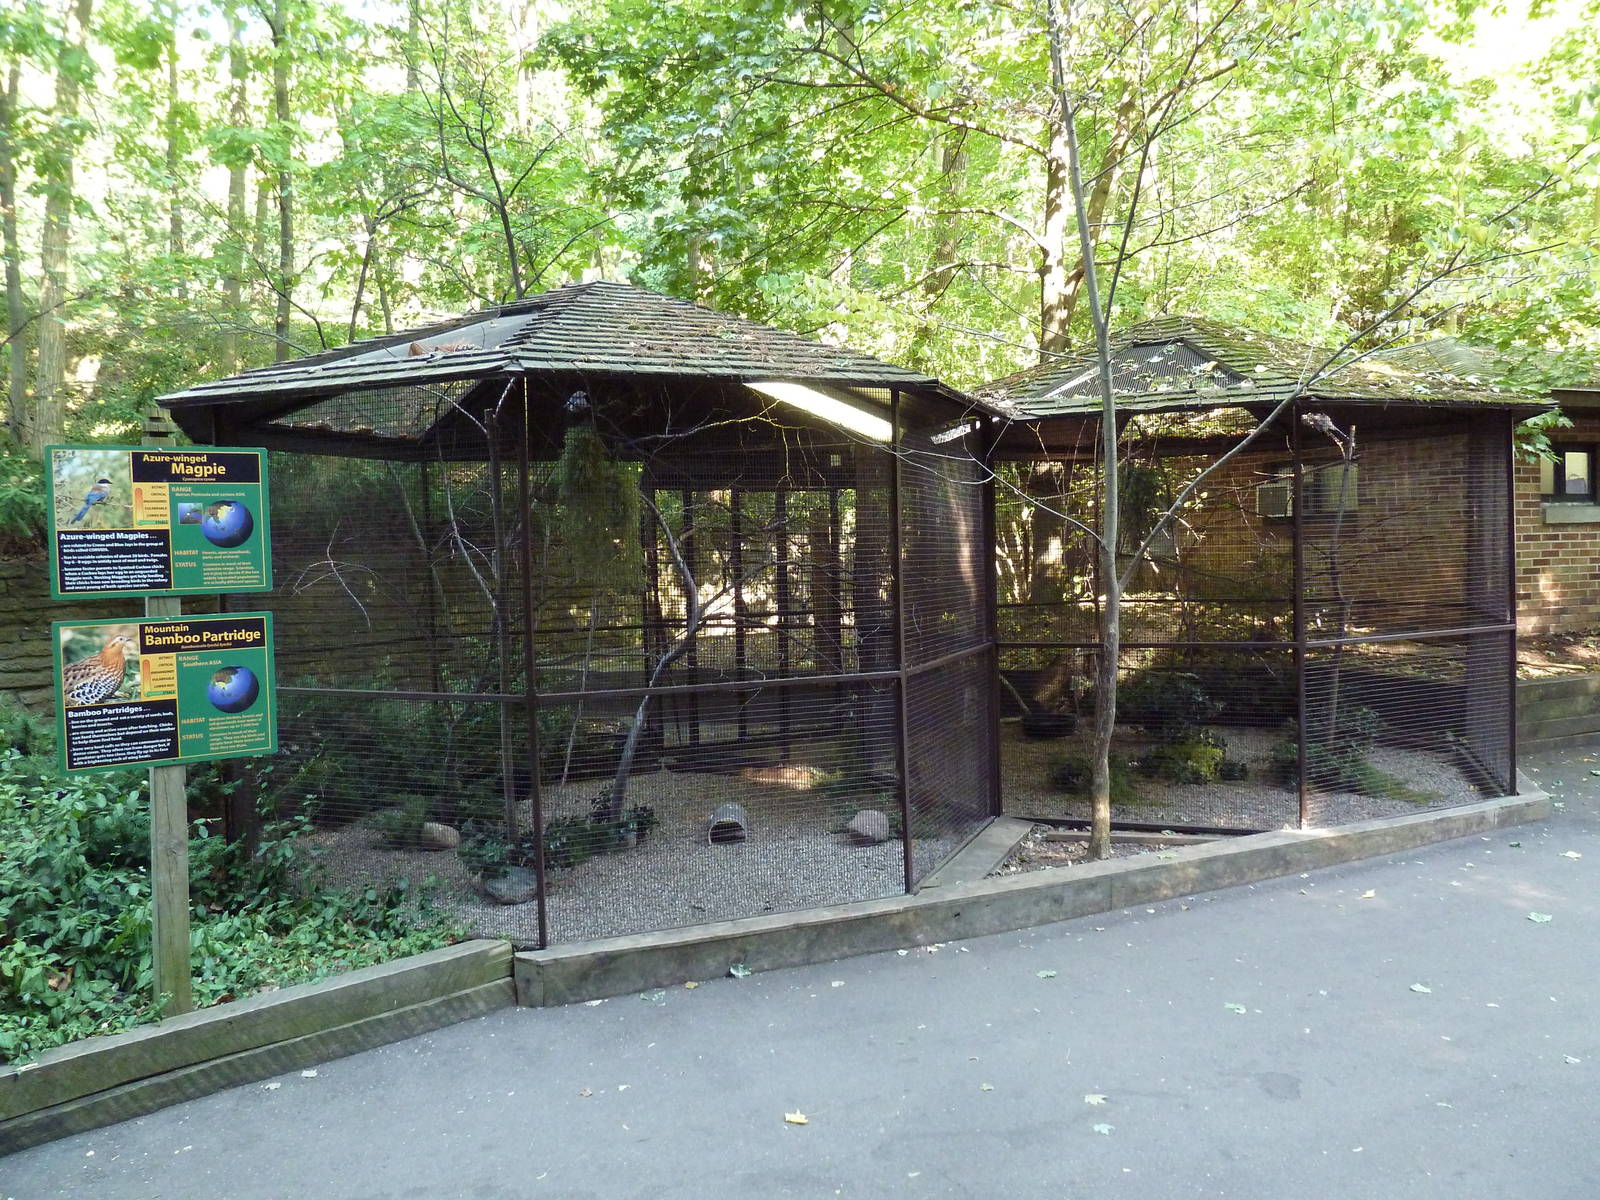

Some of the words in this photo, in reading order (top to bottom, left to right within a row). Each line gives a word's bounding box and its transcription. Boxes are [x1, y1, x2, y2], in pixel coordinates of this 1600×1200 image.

[142, 454, 207, 464] Azure-winged
[171, 462, 226, 477] Magpie
[60, 533, 115, 541] Azure-winged
[116, 532, 149, 540] Magpies
[144, 624, 189, 634] Mountain
[145, 633, 200, 646] Bamboo
[203, 629, 261, 642] Partridge
[68, 709, 101, 718] Bamboo
[103, 706, 143, 715] Partridges
